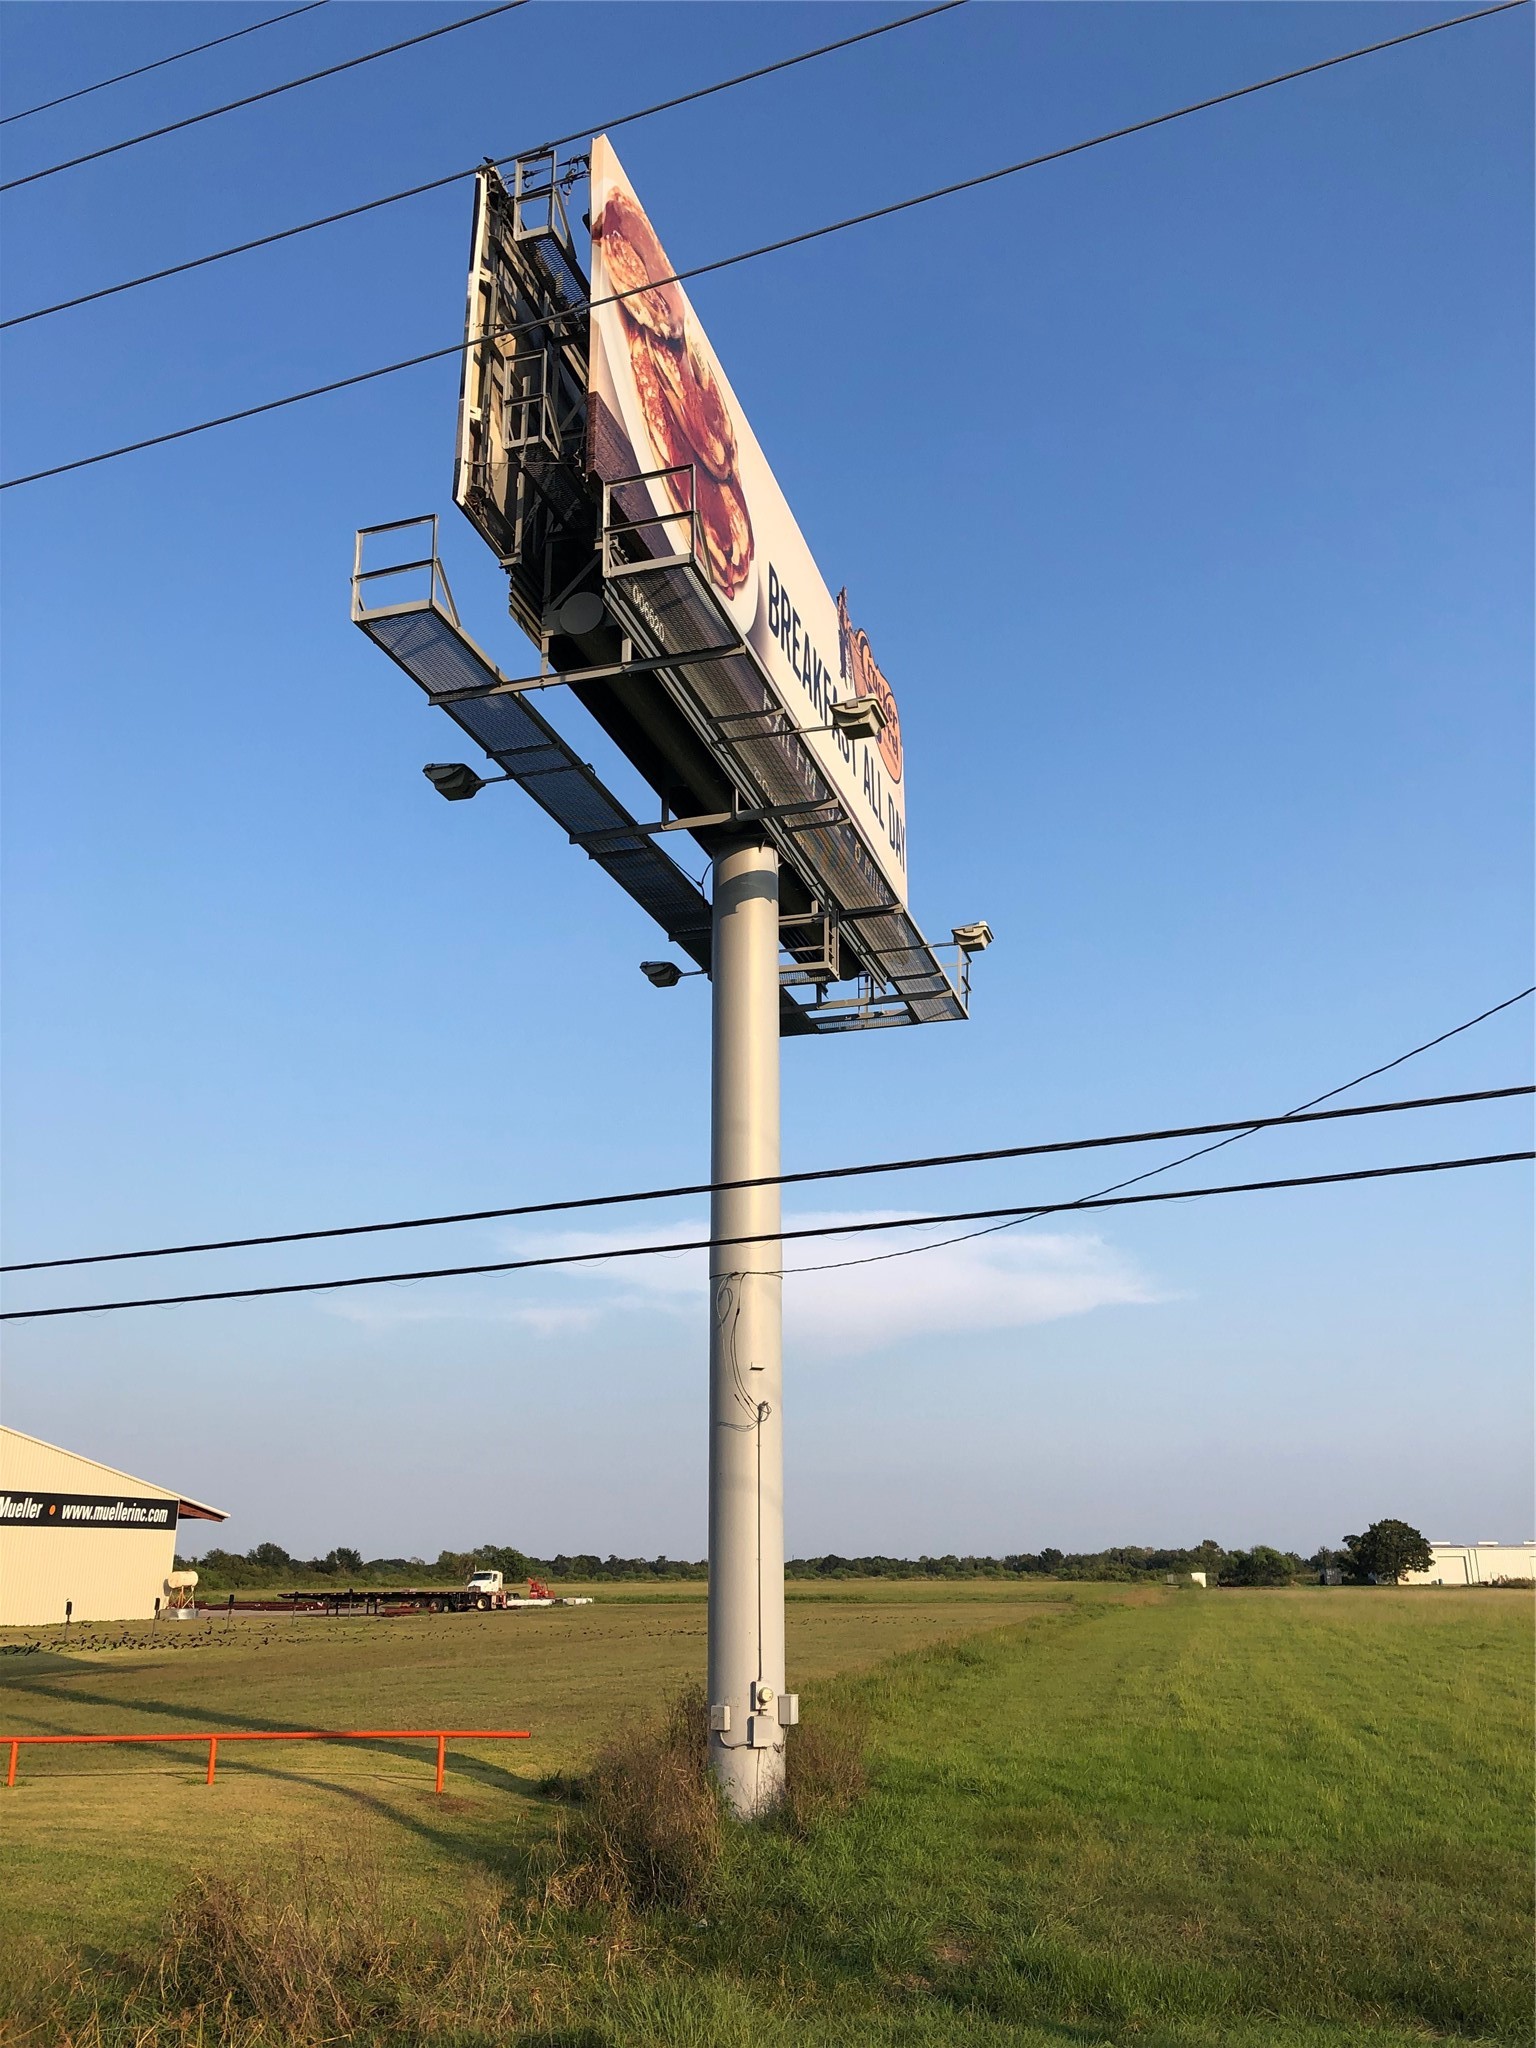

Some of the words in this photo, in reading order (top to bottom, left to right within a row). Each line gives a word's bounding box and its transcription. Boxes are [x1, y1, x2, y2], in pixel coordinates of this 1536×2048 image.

[863, 744, 885, 832] ALL
[887, 791, 905, 874] DAY
[0, 1497, 44, 1519] Mueller
[62, 1502, 168, 1523] www.muellerinc.com
